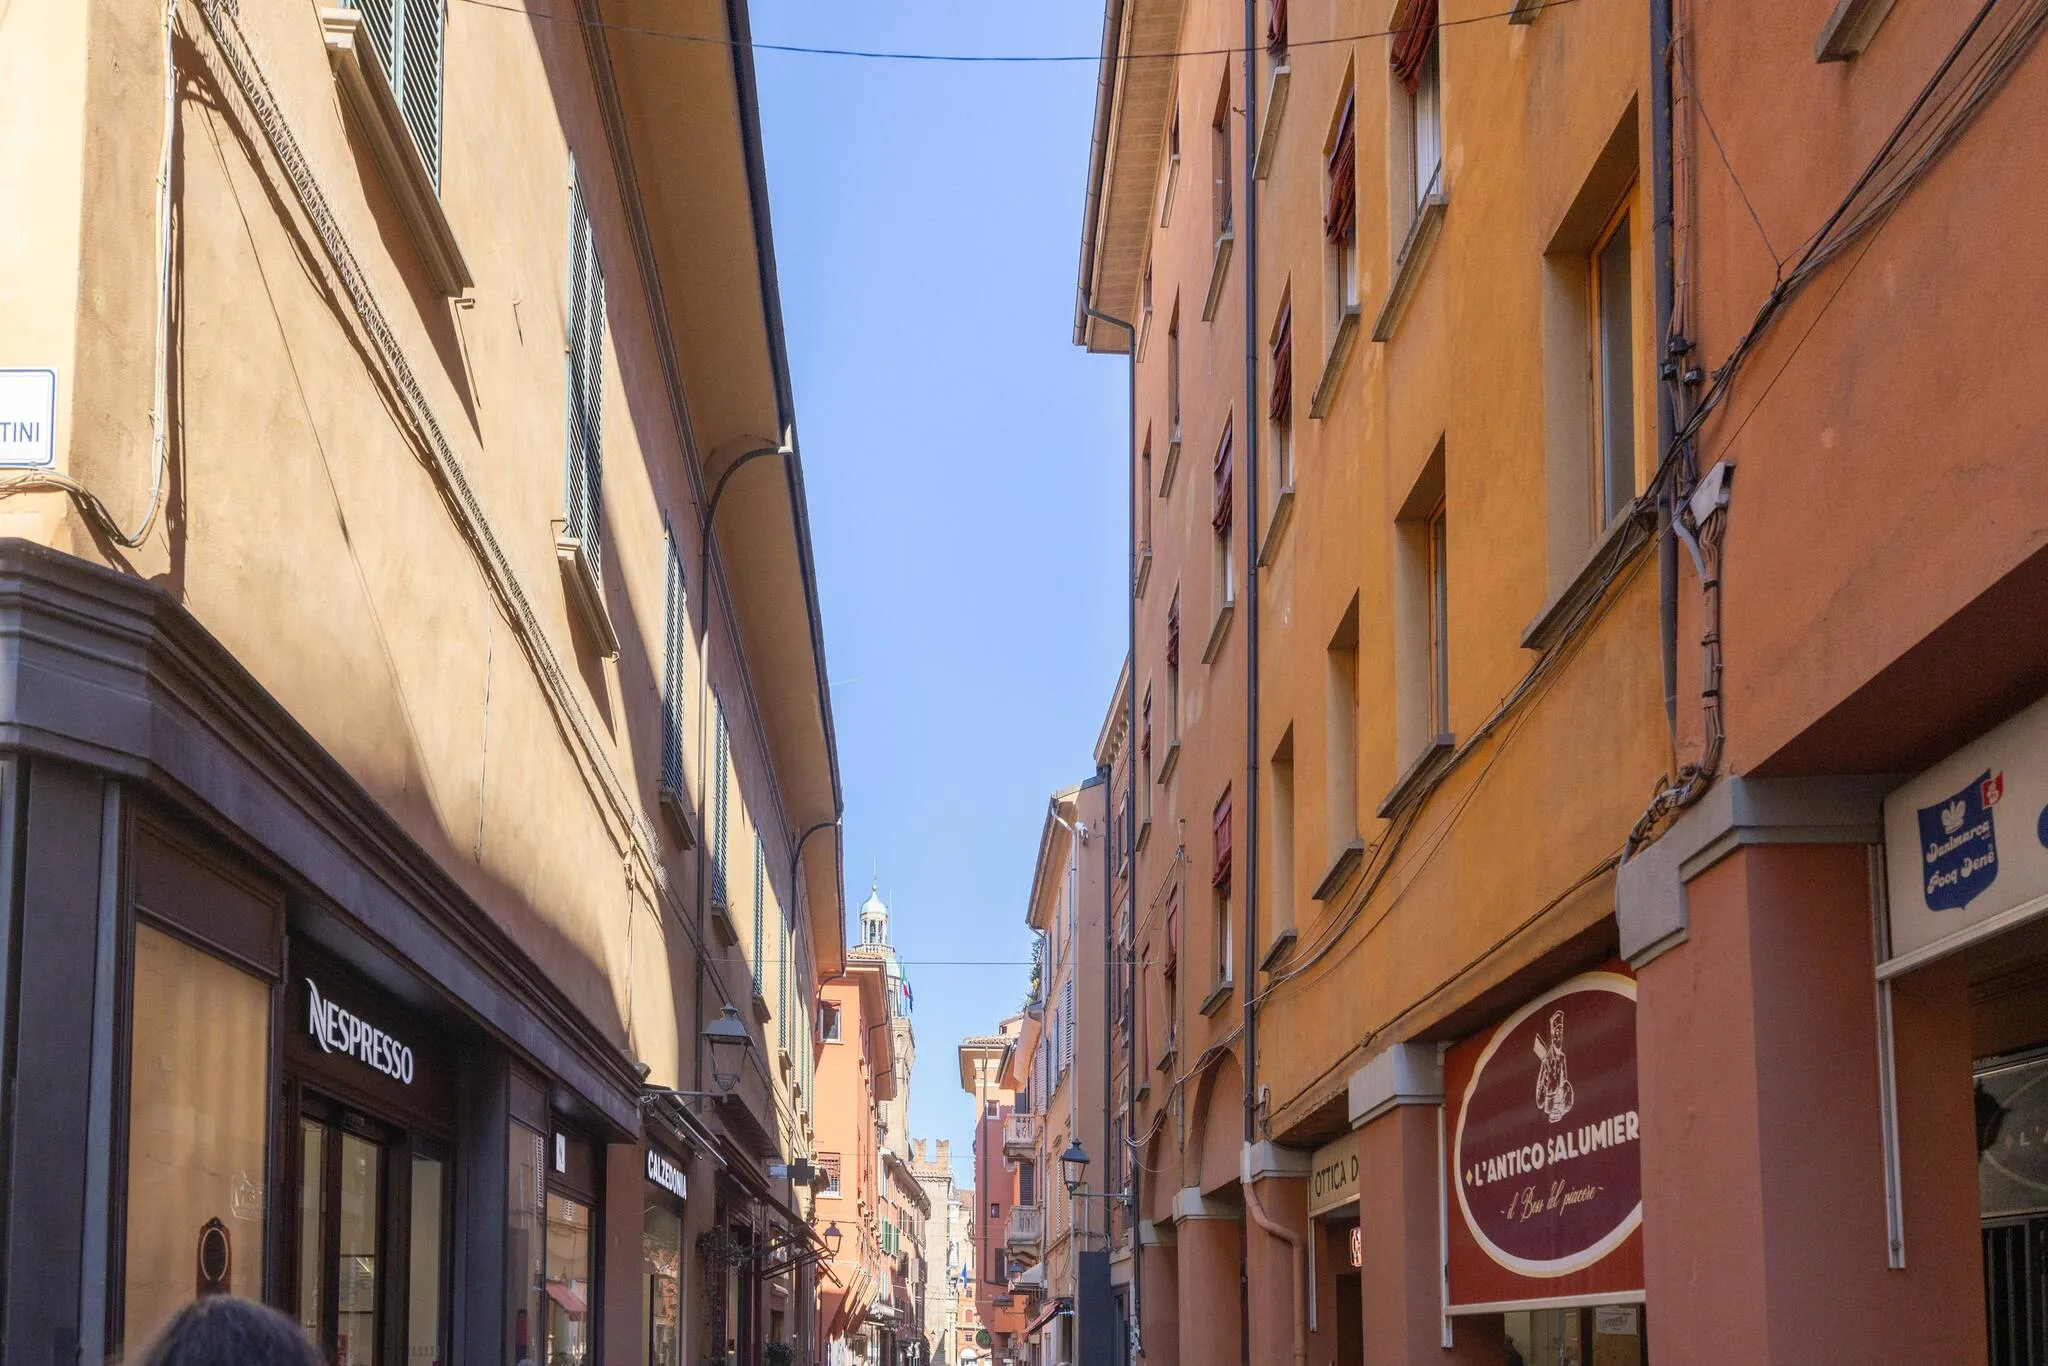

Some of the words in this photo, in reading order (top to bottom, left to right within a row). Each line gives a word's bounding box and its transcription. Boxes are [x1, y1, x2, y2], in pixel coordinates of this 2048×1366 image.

[0, 421, 40, 443] TINI
[305, 977, 414, 1085] NESPRESSO
[1475, 1142, 1545, 1187] L'ANTICO
[1547, 1110, 1640, 1165] SALUMIER
[648, 1149, 687, 1200] CALZEDONIA
[1315, 1159, 1347, 1198] OTTICA
